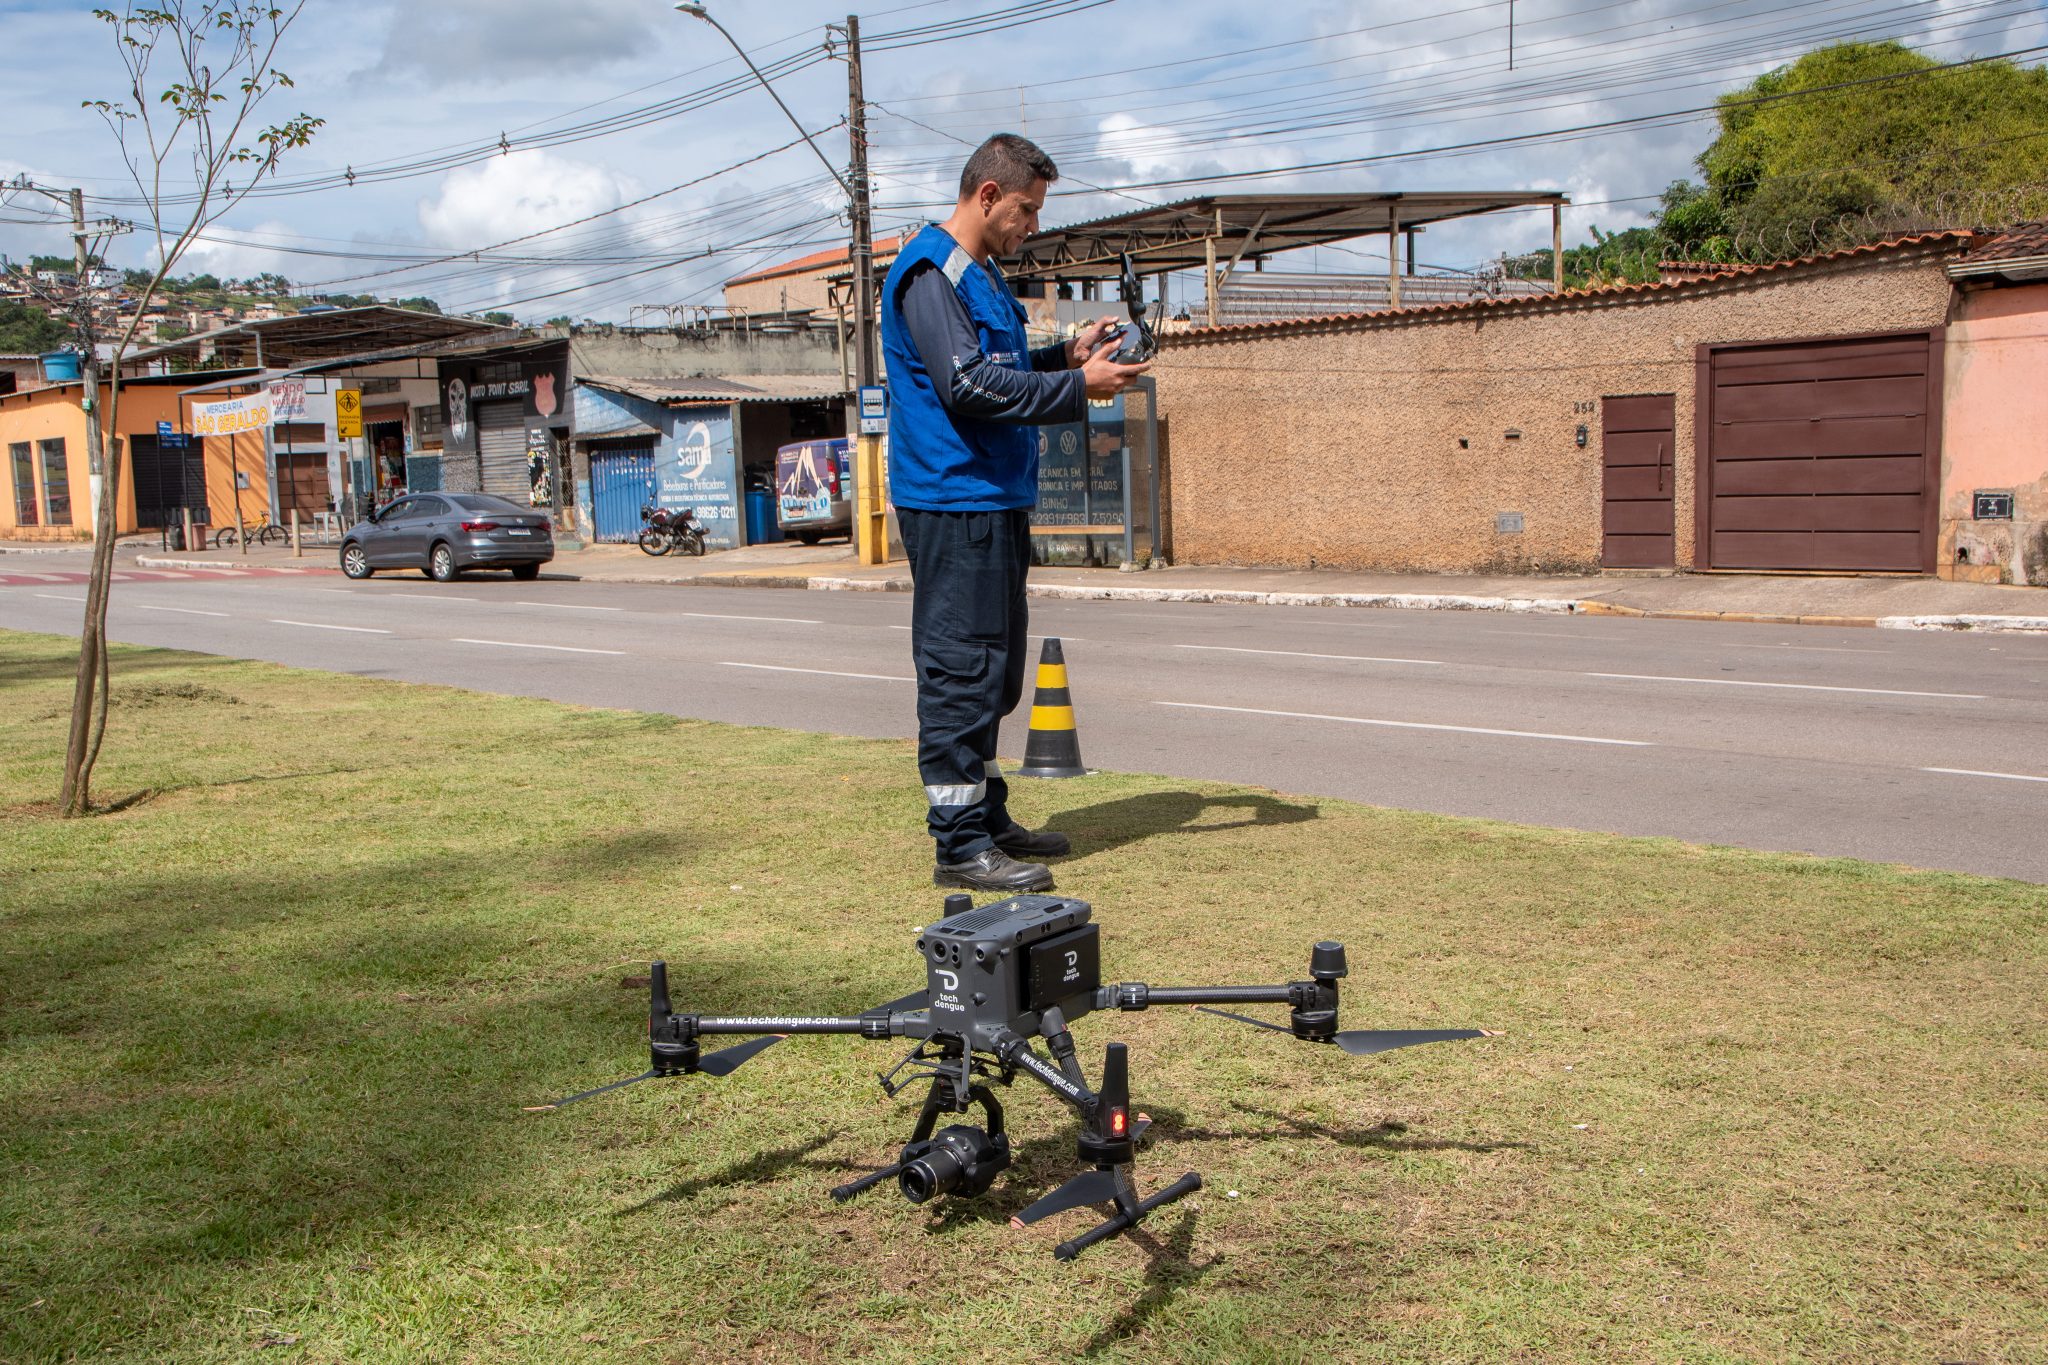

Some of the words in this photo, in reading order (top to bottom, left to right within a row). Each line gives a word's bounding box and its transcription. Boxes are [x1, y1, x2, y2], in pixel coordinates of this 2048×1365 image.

[952, 355, 1007, 404] tecdenue.com
[269, 384, 304, 395] VENDO
[206, 401, 244, 414] MERCEARIA
[195, 411, 215, 434] SÃO
[218, 406, 269, 433] GERALDO
[1038, 466, 1069, 478] ECÂNICA
[1042, 497, 1068, 510] BINHO
[940, 992, 958, 1003] tech
[934, 1000, 965, 1012] dengue
[716, 1016, 839, 1027] www.techdengue.com
[1020, 1052, 1080, 1096] www.techdengue.com
